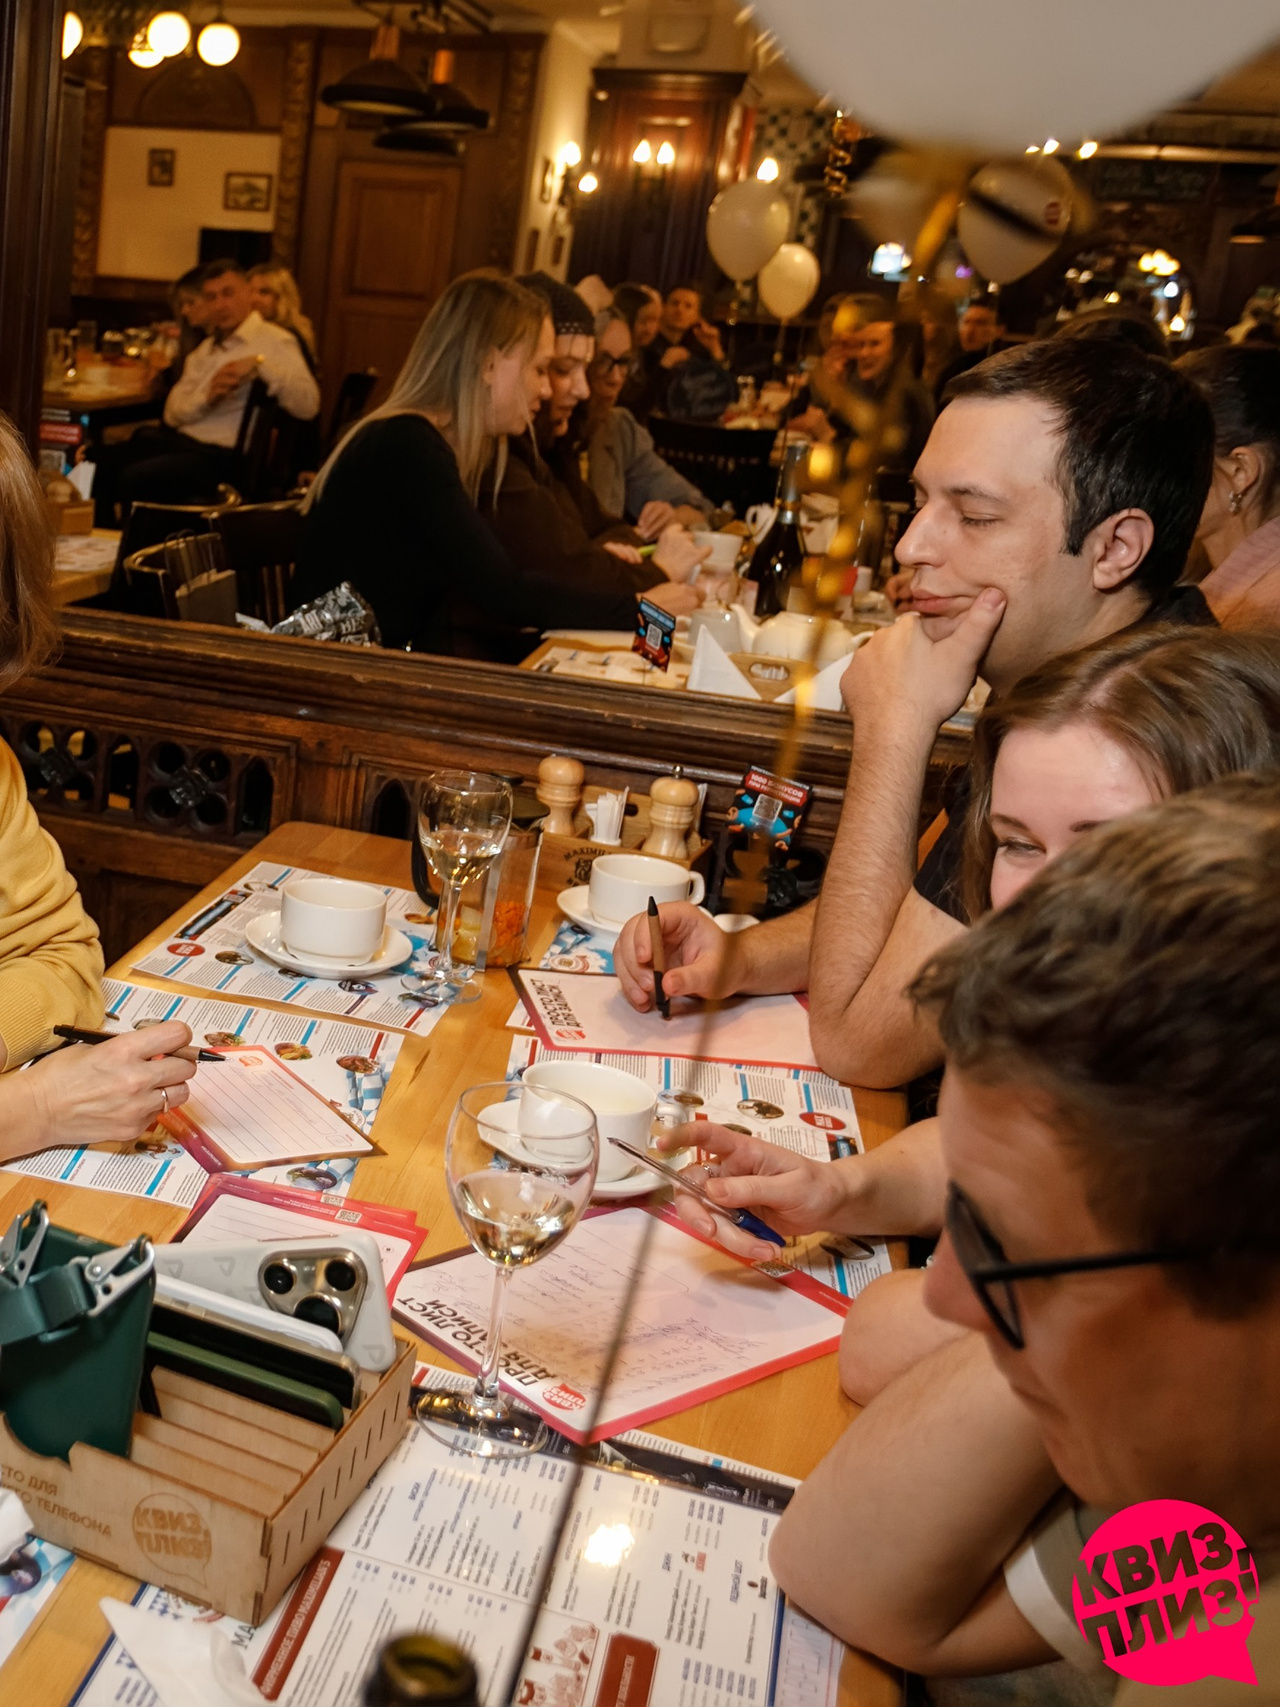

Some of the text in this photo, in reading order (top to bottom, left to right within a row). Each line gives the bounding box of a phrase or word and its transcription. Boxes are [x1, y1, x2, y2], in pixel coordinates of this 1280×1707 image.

[397, 1297, 455, 1330] ЛИСТ
[505, 1350, 557, 1380] ДЛЯ
[28, 1476, 58, 1496] ДЛЯ
[37, 1497, 112, 1537] ТЕЛЕФОНА
[135, 1508, 210, 1537] КВИЗ,
[135, 1531, 211, 1561] ПЛИЗ!
